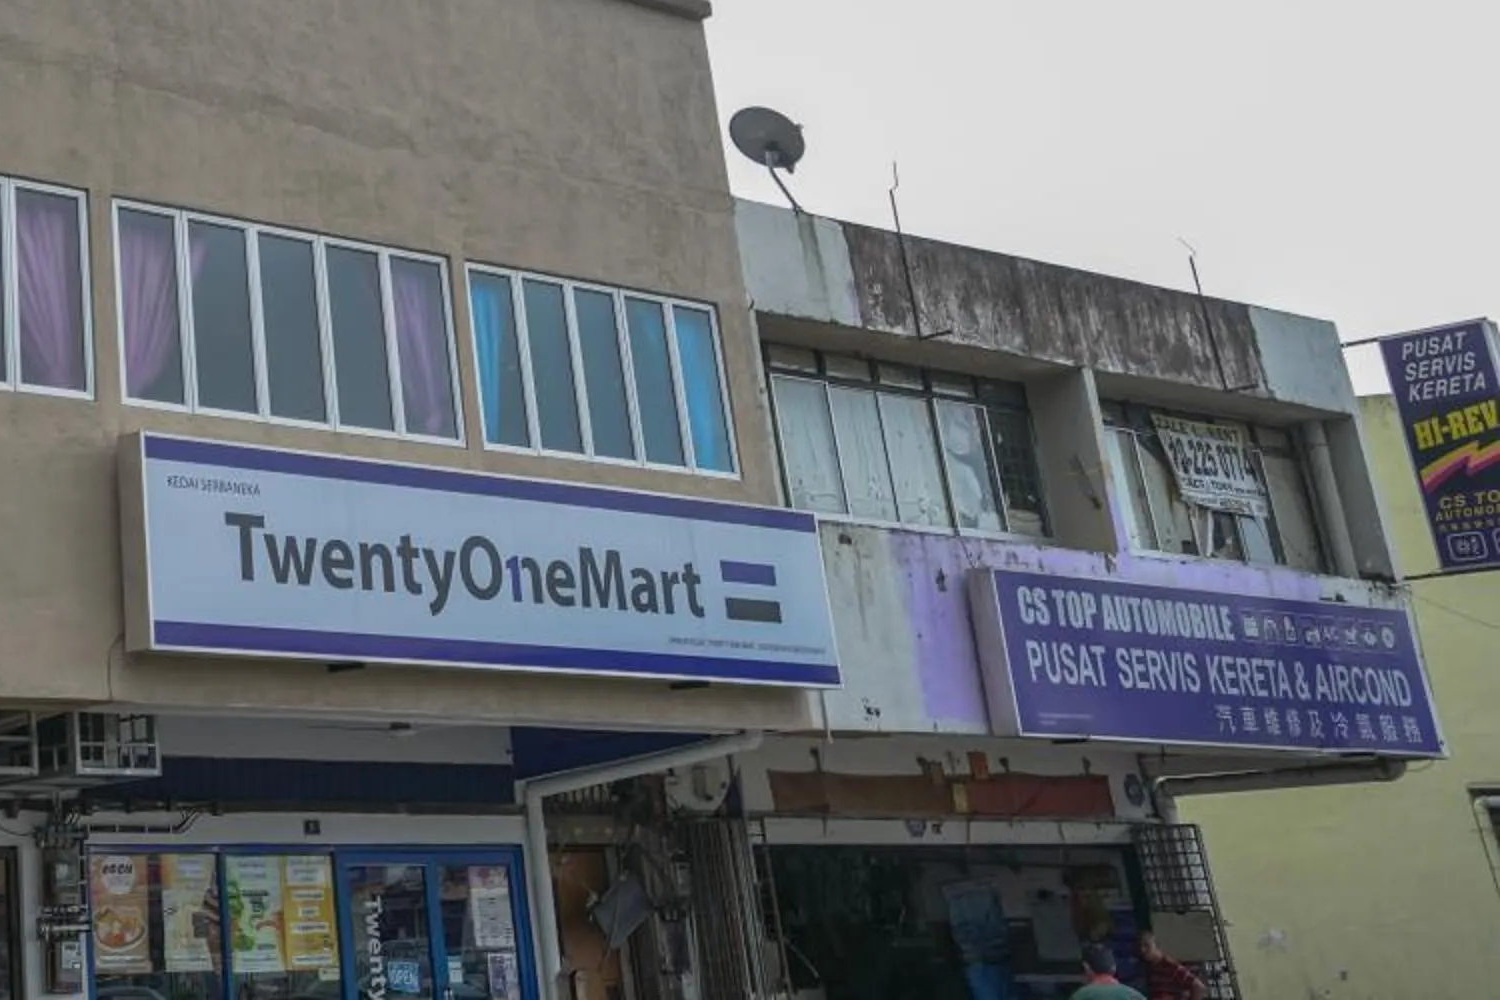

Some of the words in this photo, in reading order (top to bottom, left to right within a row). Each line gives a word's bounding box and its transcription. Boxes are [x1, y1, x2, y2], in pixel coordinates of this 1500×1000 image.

[1402, 331, 1467, 361] PUSAT
[1404, 351, 1476, 382] SERVIS
[1409, 371, 1486, 403] KERETA
[1413, 400, 1498, 451] HI-REV
[1439, 494, 1466, 510] CS
[225, 512, 706, 618] TwentyOneMart
[1017, 585, 1052, 626] CS
[1056, 592, 1097, 630] TOP
[1103, 596, 1236, 642] AUTOMOBILE
[1025, 640, 1107, 687] PUSAT
[1116, 649, 1200, 694] SERVIS
[1206, 655, 1291, 699] KERETA
[1295, 664, 1311, 700] &
[1314, 662, 1413, 708] AIRCOND
